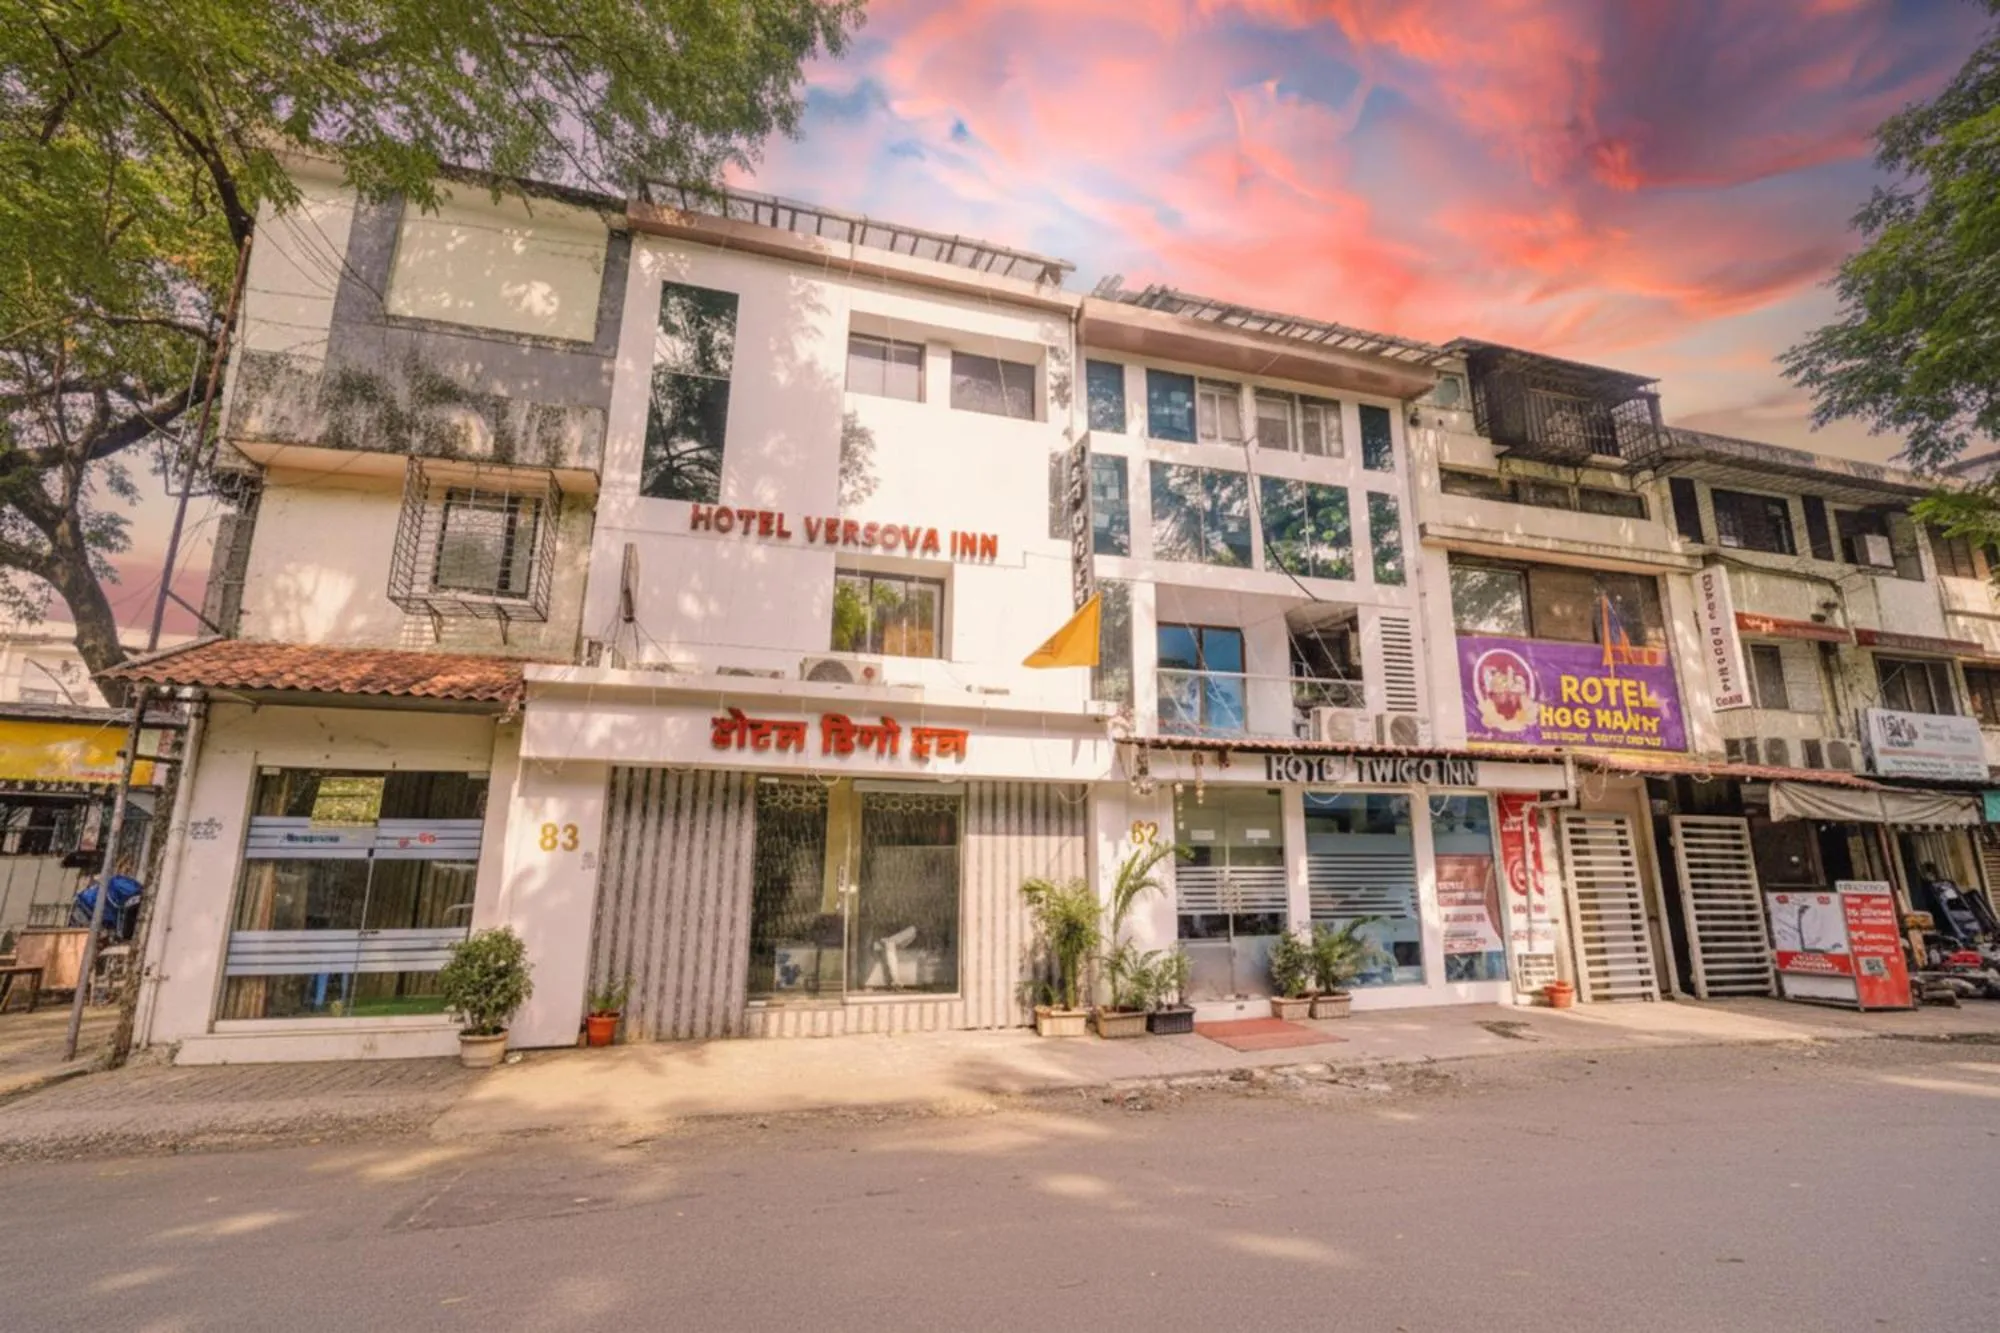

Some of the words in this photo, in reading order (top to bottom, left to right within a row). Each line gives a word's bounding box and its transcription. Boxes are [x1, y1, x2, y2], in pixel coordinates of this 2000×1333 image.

[690, 503, 792, 539] HOTEL
[804, 516, 940, 553] VERSOVA
[950, 529, 998, 560] INN
[539, 822, 579, 852] 83
